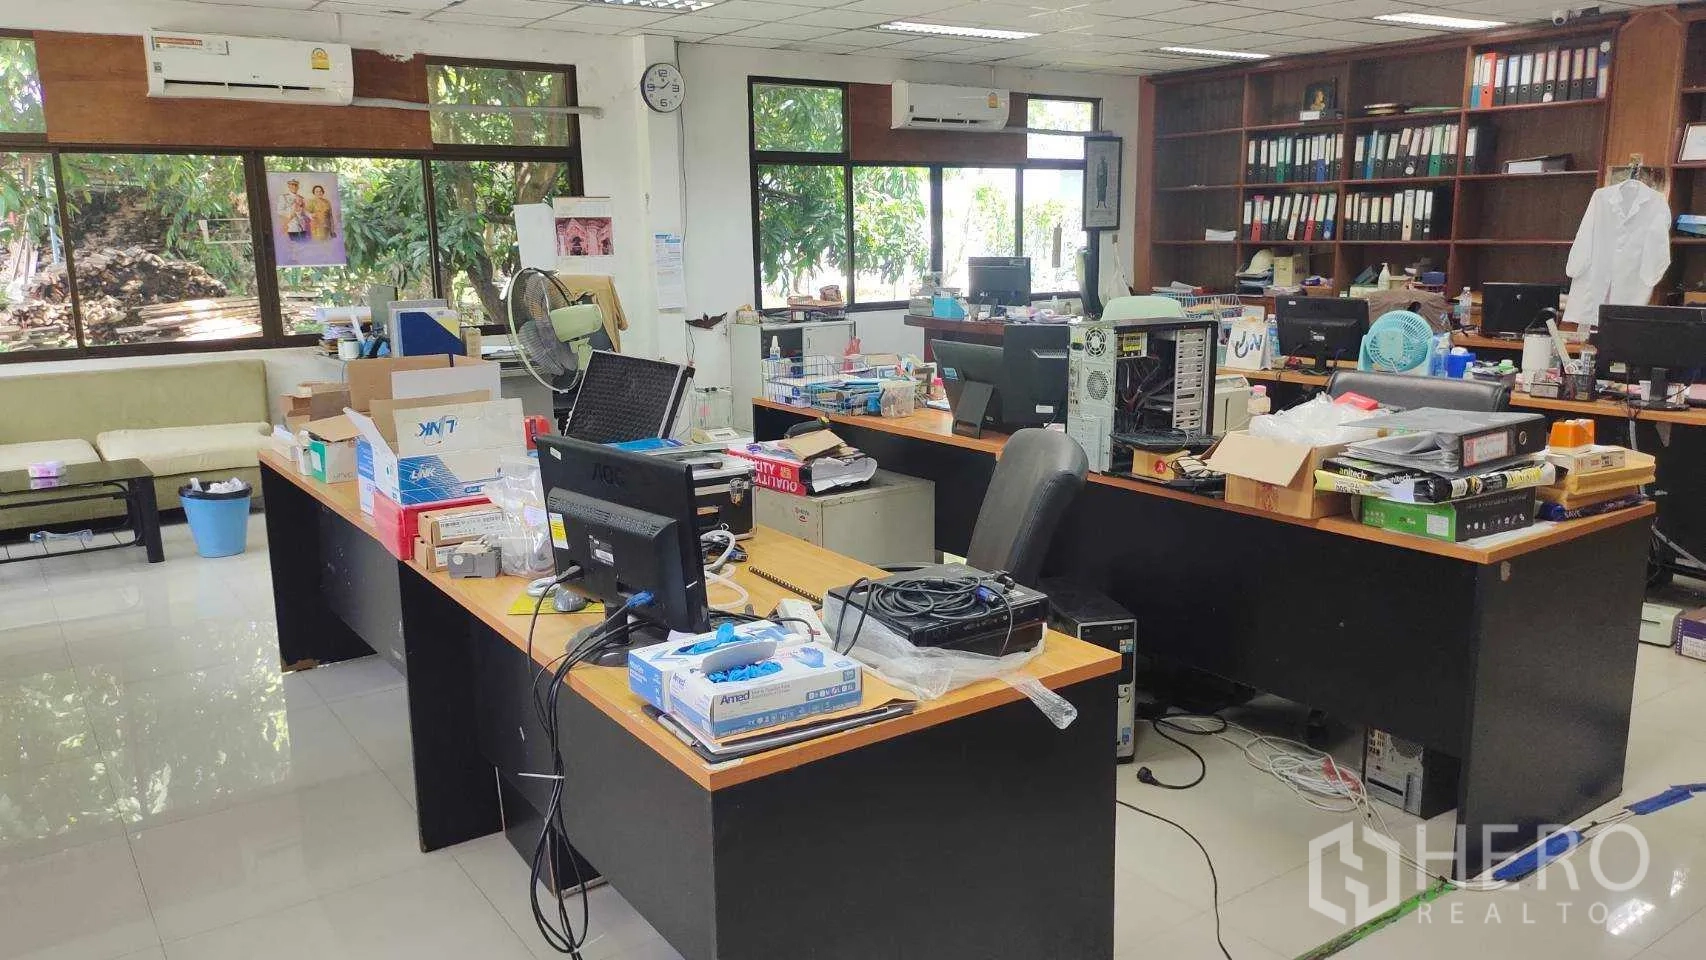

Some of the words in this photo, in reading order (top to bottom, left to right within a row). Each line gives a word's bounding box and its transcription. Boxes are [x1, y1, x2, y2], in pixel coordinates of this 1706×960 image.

[660, 99, 667, 107] 6
[1339, 467, 1368, 480] anitech
[755, 473, 797, 492] QUALITY
[720, 690, 750, 706] Amed
